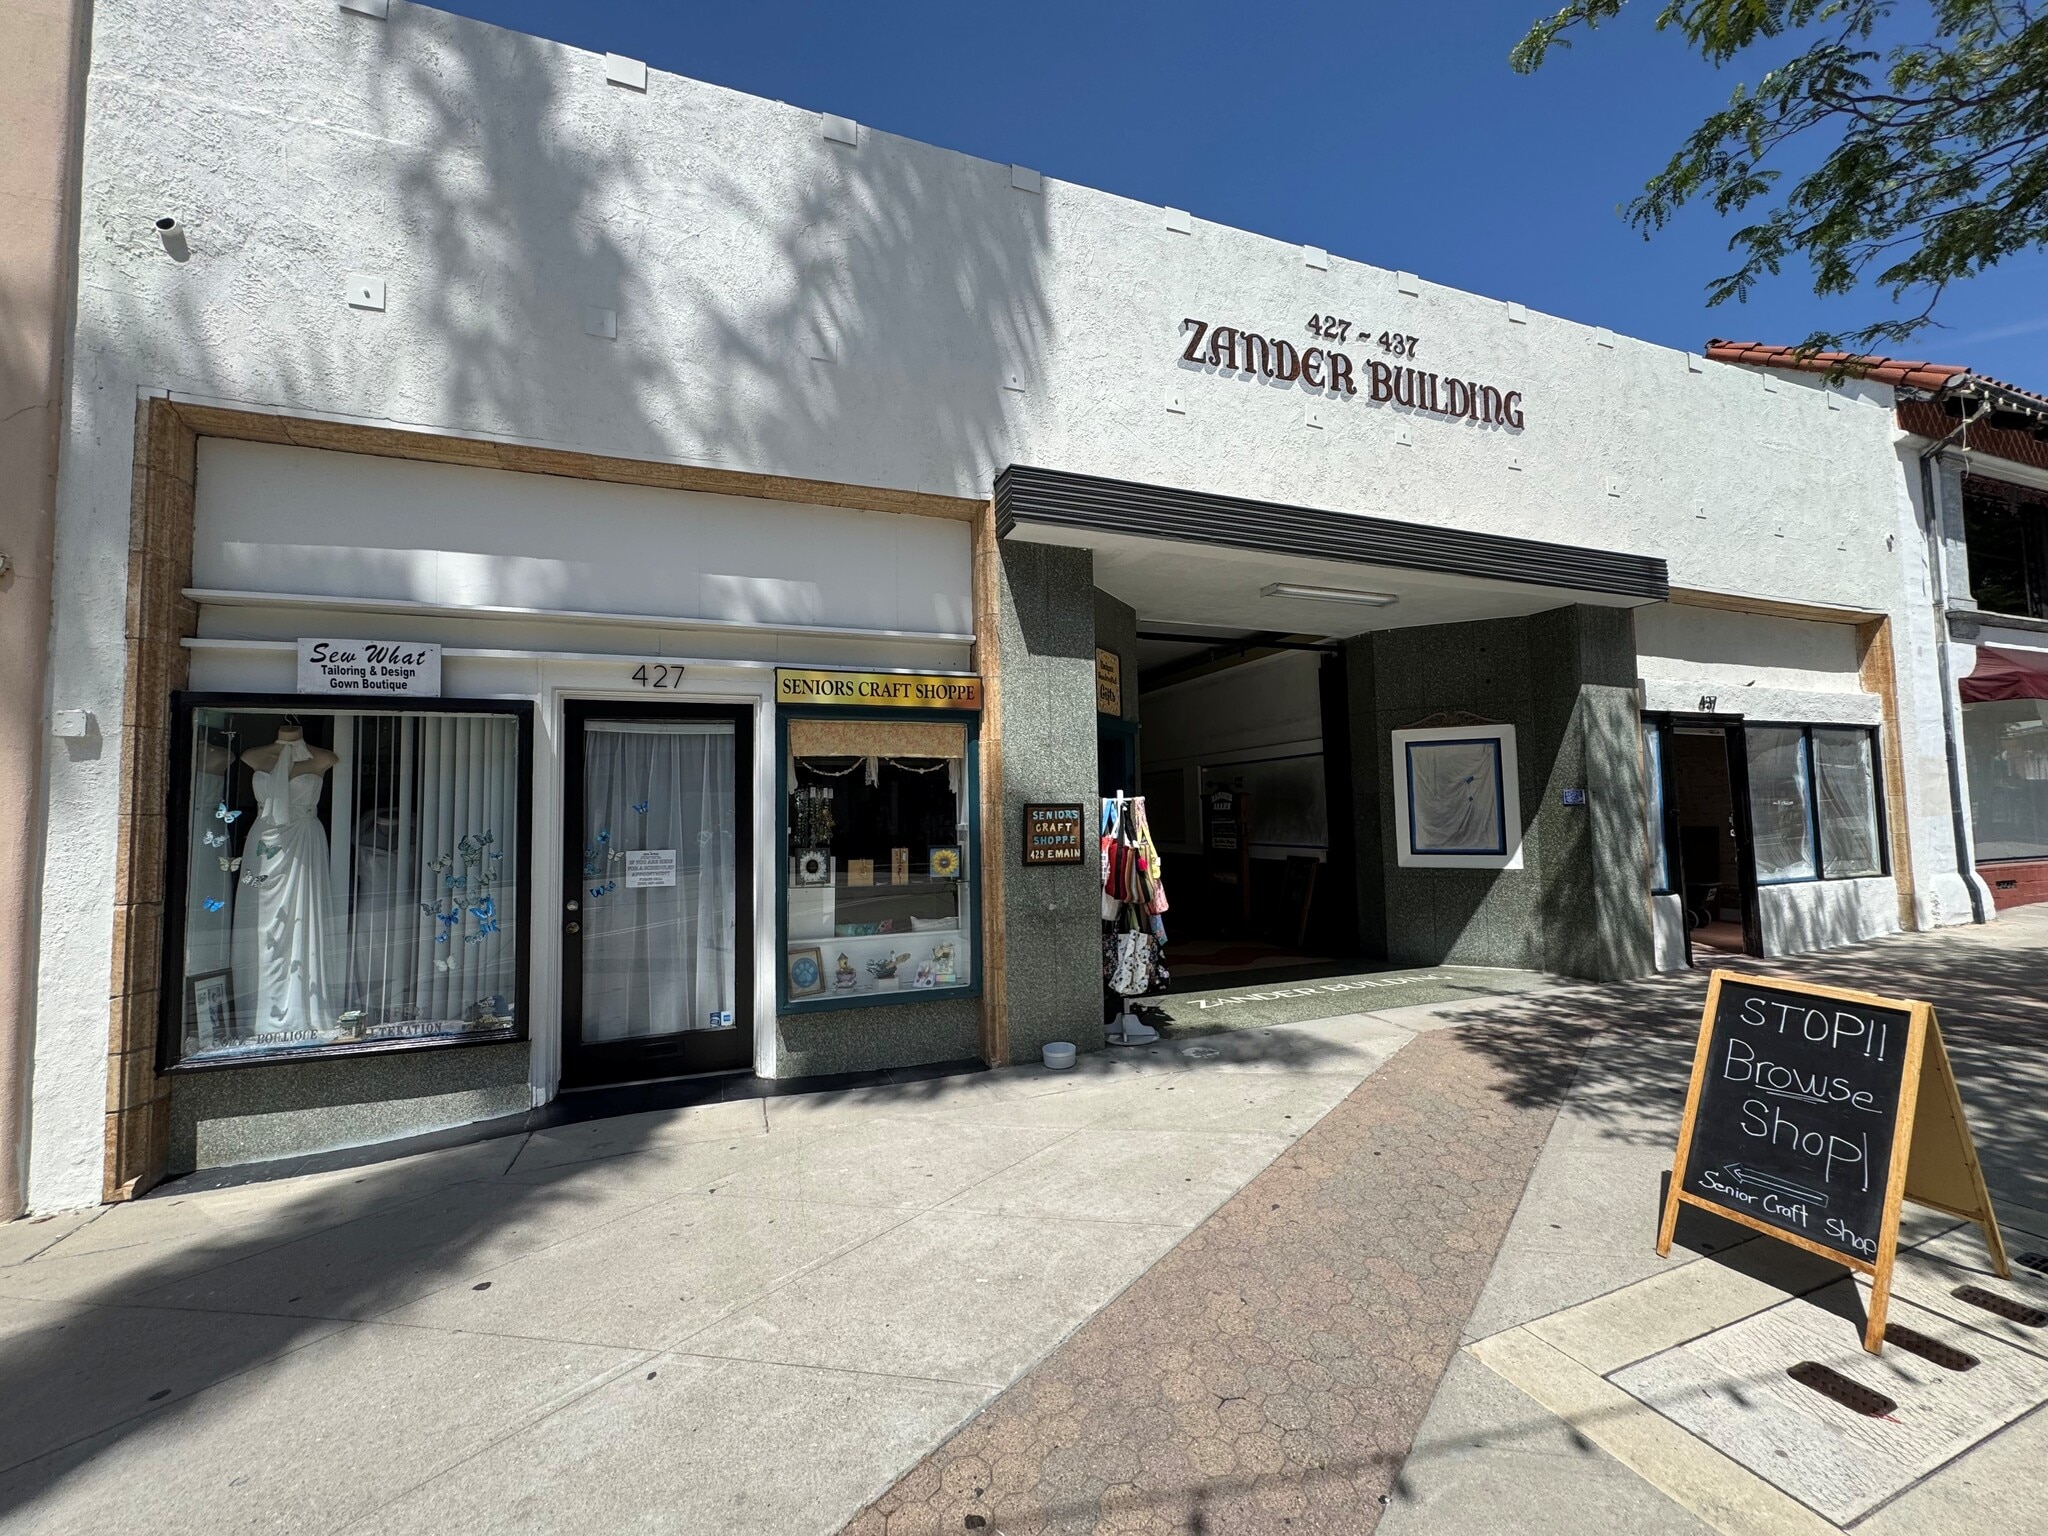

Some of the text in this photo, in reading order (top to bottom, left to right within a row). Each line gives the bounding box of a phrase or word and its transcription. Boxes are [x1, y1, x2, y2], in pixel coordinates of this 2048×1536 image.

[1308, 313, 1352, 342] 427
[1379, 331, 1420, 358] 437
[1184, 318, 1525, 430] ZANDER BUILDING
[310, 643, 426, 665] Sew What
[321, 665, 415, 679] Tailoring & Design
[631, 664, 685, 689] 427
[330, 678, 408, 692] Gown Boutique
[782, 678, 976, 700] SENIORS CRAFT SHOPPE
[1698, 695, 1717, 711] 437
[1032, 809, 1079, 820] SENIORS
[1035, 822, 1072, 832] CRAFT
[1033, 835, 1076, 845] SHOPPE
[1030, 849, 1045, 859] 429
[1187, 987, 1324, 1009] ZANDER
[366, 1022, 443, 1038] LTERATION
[1740, 997, 1887, 1061] STOP!!
[1723, 1039, 1882, 1114] Browse
[1740, 1099, 1870, 1192] Shop!
[1699, 1170, 1758, 1205] Senior
[1763, 1194, 1808, 1228] Craft
